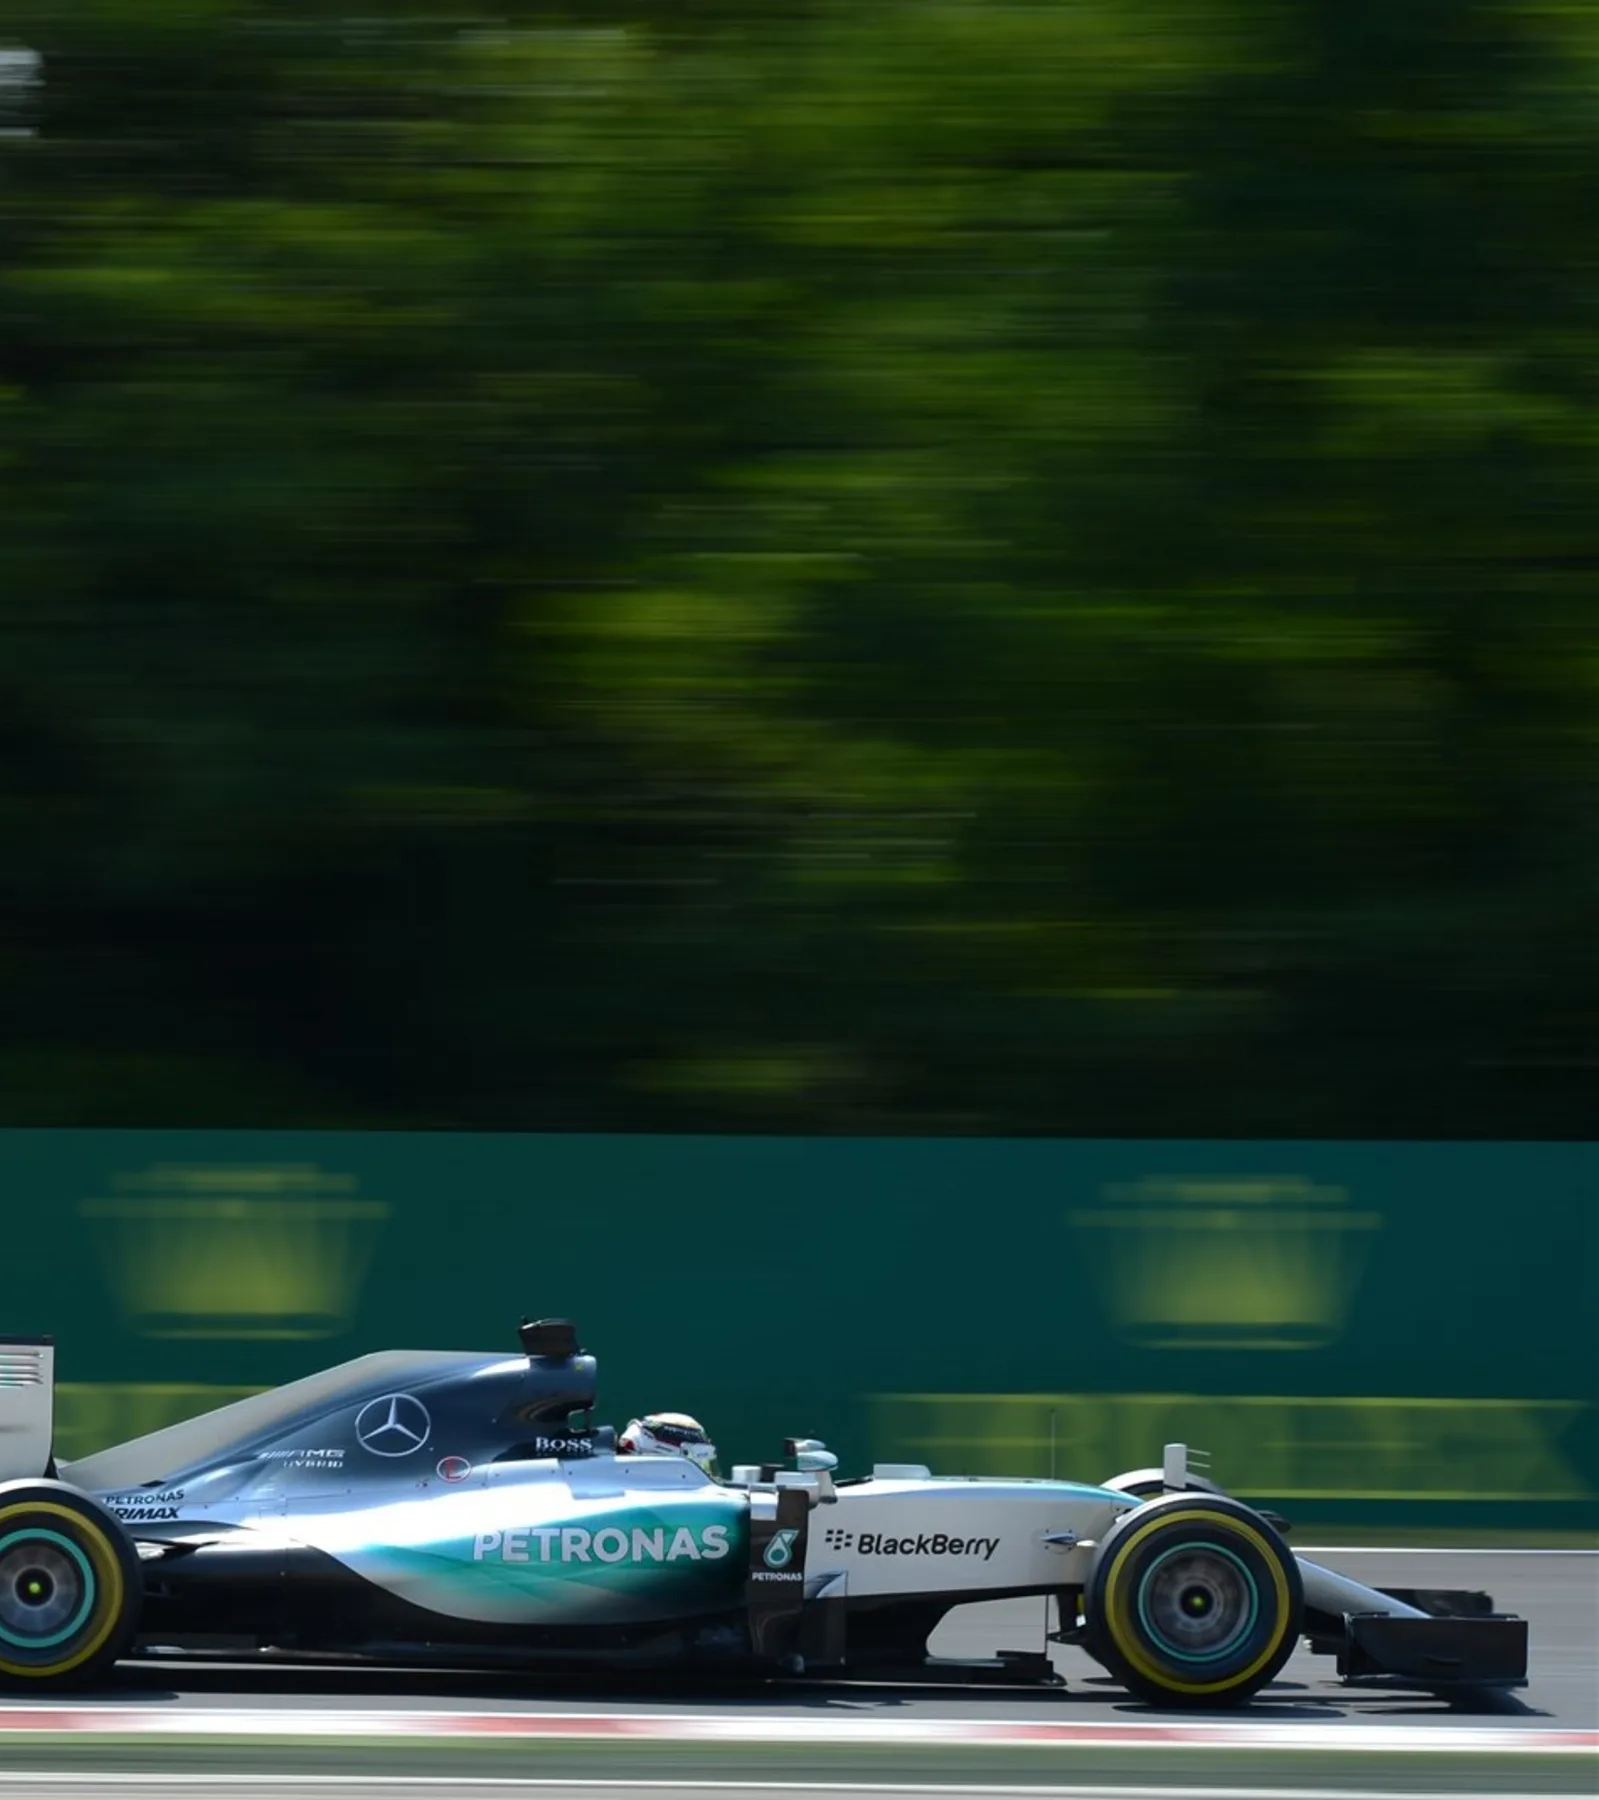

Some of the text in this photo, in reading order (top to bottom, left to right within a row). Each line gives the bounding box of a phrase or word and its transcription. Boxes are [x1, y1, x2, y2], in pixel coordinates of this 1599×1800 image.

[535, 1436, 593, 1449] BOSS
[105, 1489, 185, 1505] PETRONAS
[109, 1506, 184, 1520] RIMAX
[473, 1525, 730, 1563] PETRONAS
[857, 1533, 1000, 1561] BlackBerry
[751, 1571, 803, 1582] PETRONAS
